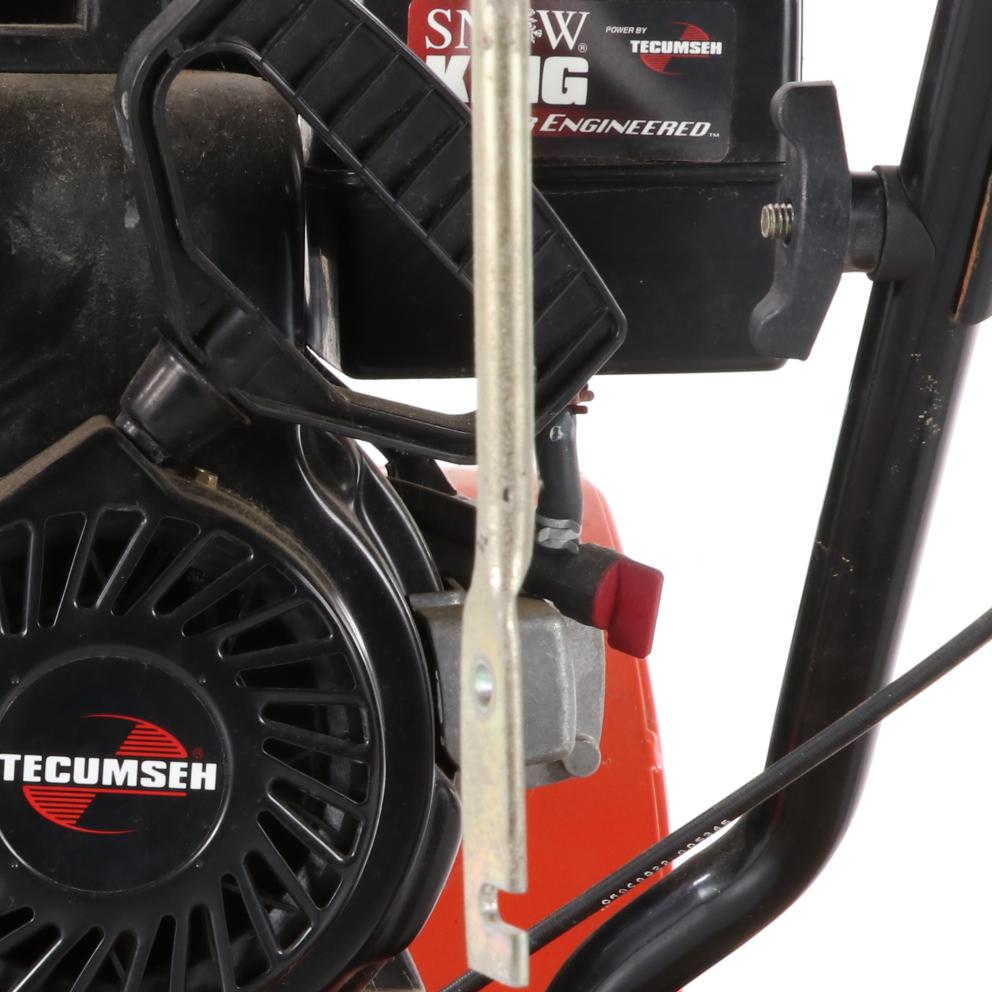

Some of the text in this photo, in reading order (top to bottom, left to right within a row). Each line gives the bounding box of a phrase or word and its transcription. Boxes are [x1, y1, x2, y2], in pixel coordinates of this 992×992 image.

[605, 26, 647, 34] POWER BY
[630, 40, 722, 55] TECUMSEH
